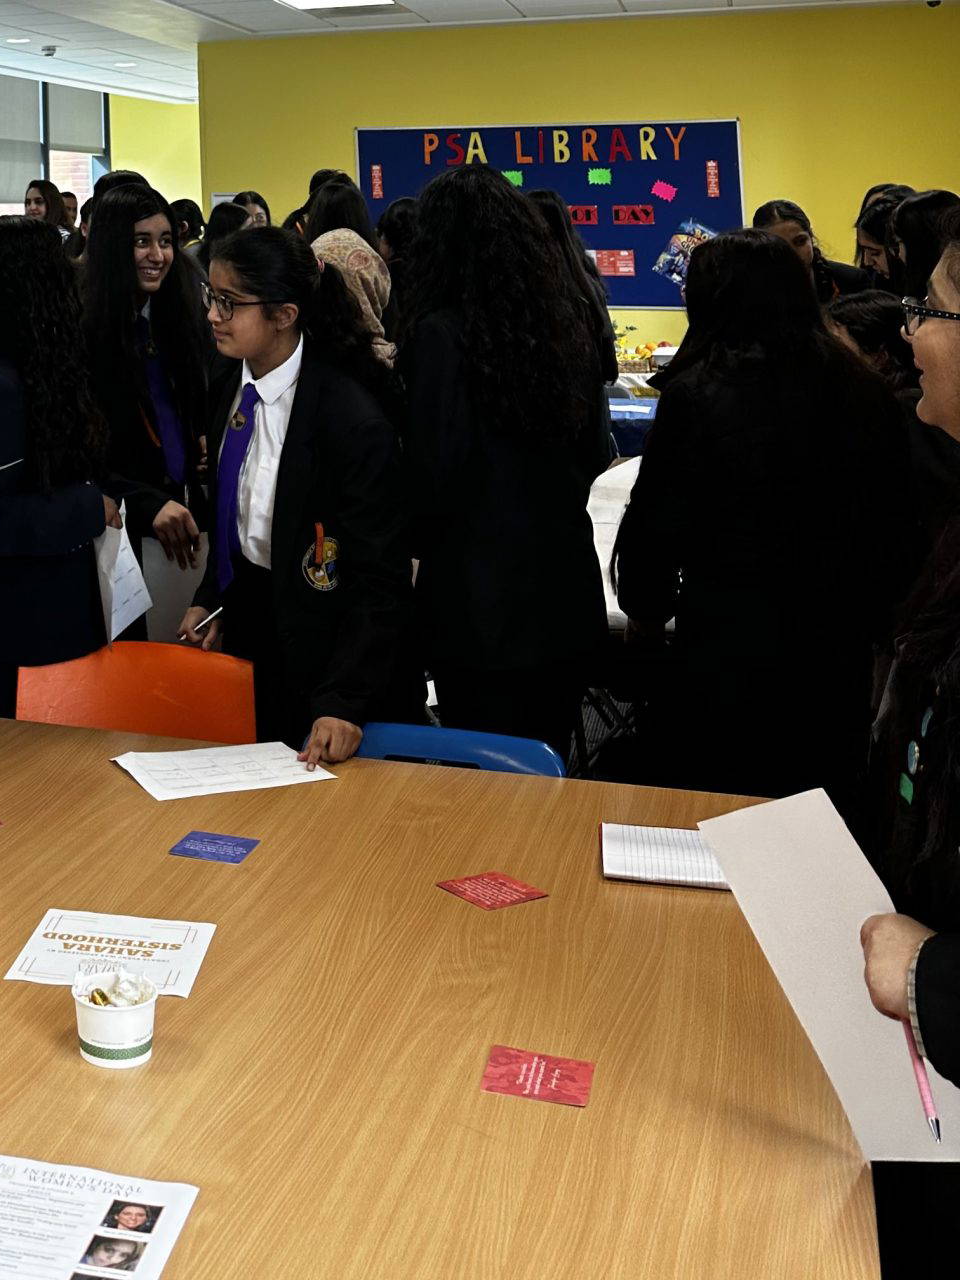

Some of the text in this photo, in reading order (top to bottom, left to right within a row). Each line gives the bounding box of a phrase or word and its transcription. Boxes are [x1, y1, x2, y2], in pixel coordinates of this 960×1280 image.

[423, 126, 688, 166] PSA LIBRARY
[613, 208, 655, 222] DAY
[42, 932, 183, 951] SISTERHOOD
[62, 942, 155, 958] SAHARA
[23, 1167, 144, 1193] INTERNATIONAL
[27, 1175, 96, 1192] WOMEN'S
[101, 1186, 130, 1198] DAY
